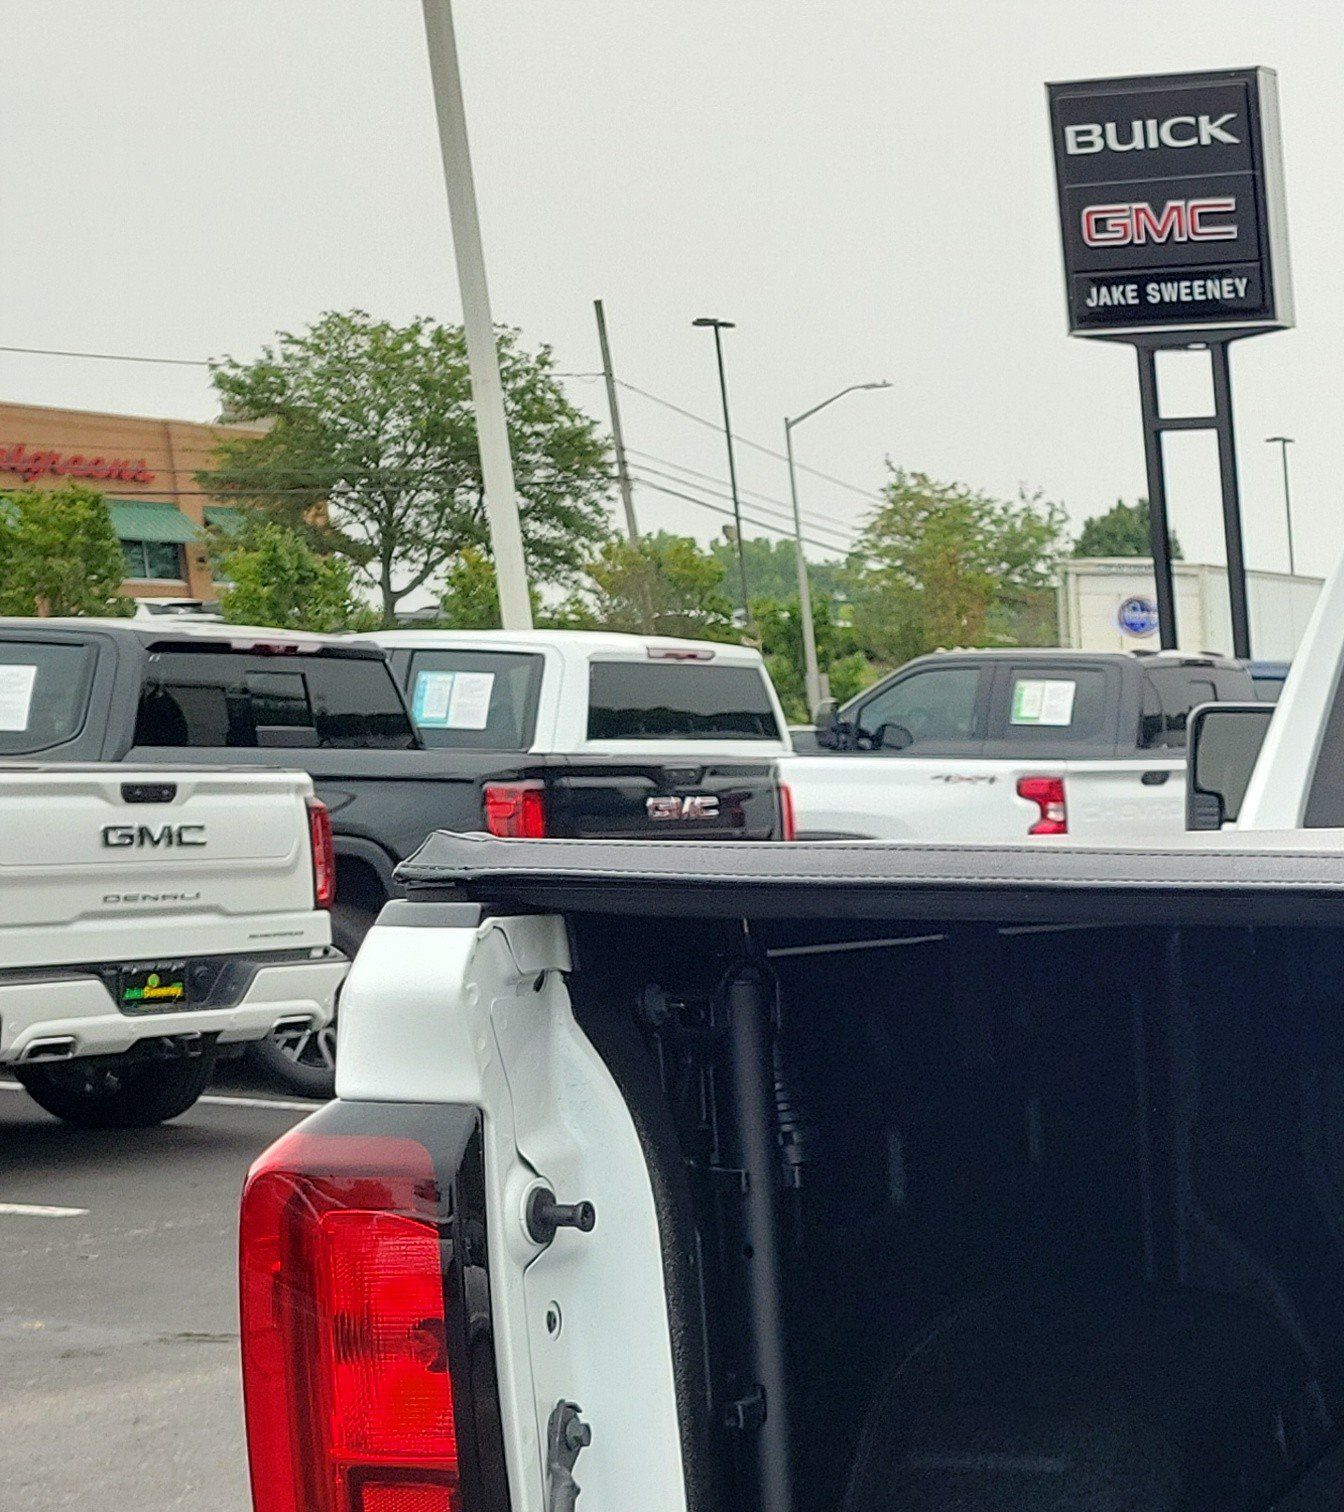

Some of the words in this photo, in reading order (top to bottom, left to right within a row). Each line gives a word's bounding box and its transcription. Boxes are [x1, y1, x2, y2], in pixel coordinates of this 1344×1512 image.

[1064, 113, 1241, 155] BUICK
[1081, 197, 1238, 247] GMC
[1085, 283, 1140, 308] JAKE
[1146, 277, 1249, 305] SWEENEY
[100, 824, 207, 848] GMC
